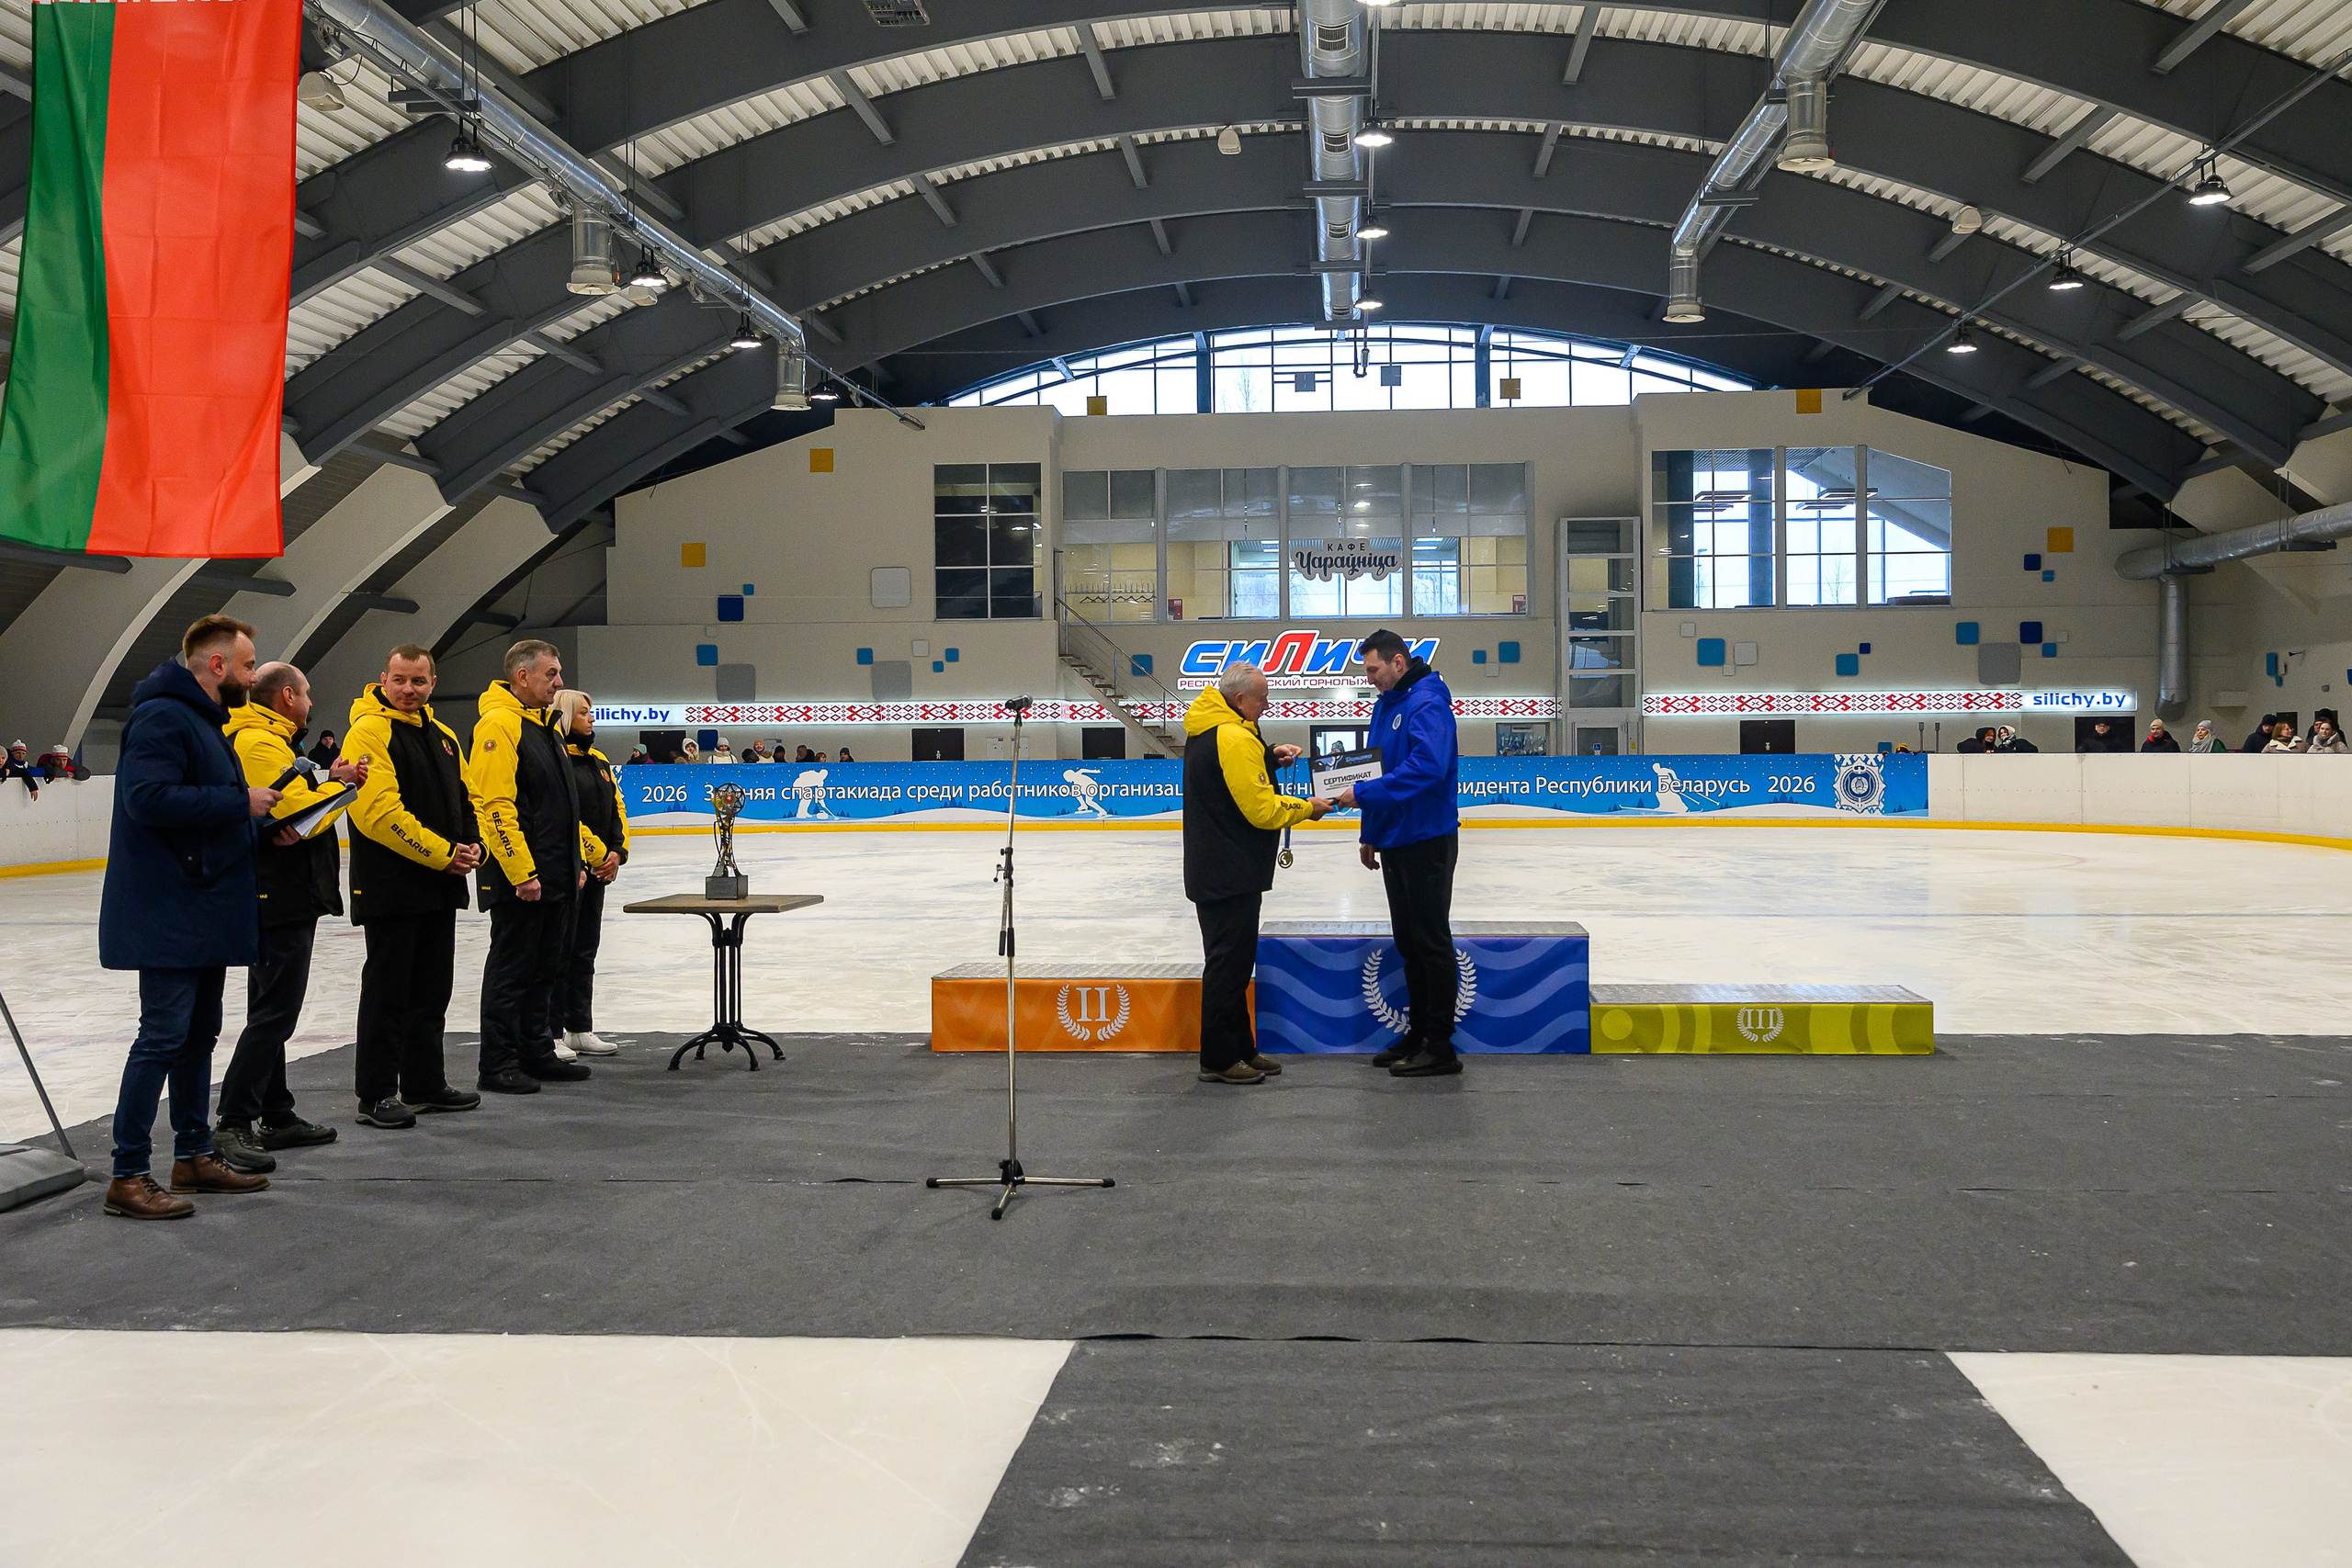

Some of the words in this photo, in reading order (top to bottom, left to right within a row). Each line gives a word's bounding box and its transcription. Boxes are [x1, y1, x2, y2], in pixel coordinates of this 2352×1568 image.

[1328, 543, 1365, 551] КАФЕ
[1180, 678, 1301, 688] РЕСПУСКИЙ
[1303, 679, 1369, 687] ГОРНОЛЫЖ
[2033, 693, 2126, 707] silichy.by
[1324, 772, 1372, 785] СЕРТИФИКАТ
[642, 785, 688, 803] 2026
[703, 784, 775, 802] Зняя
[781, 785, 901, 803] спартакиада
[907, 784, 963, 802] среди
[968, 780, 1082, 801] работников
[1085, 783, 1183, 801] организац
[1535, 775, 1652, 798] Республики
[1657, 775, 1750, 797] Беларусь
[1768, 775, 1815, 793] 2026
[390, 823, 432, 857] BELARUS
[492, 811, 515, 858] BELARUS
[1076, 987, 1111, 1021] II
[1745, 1009, 1776, 1029] III
